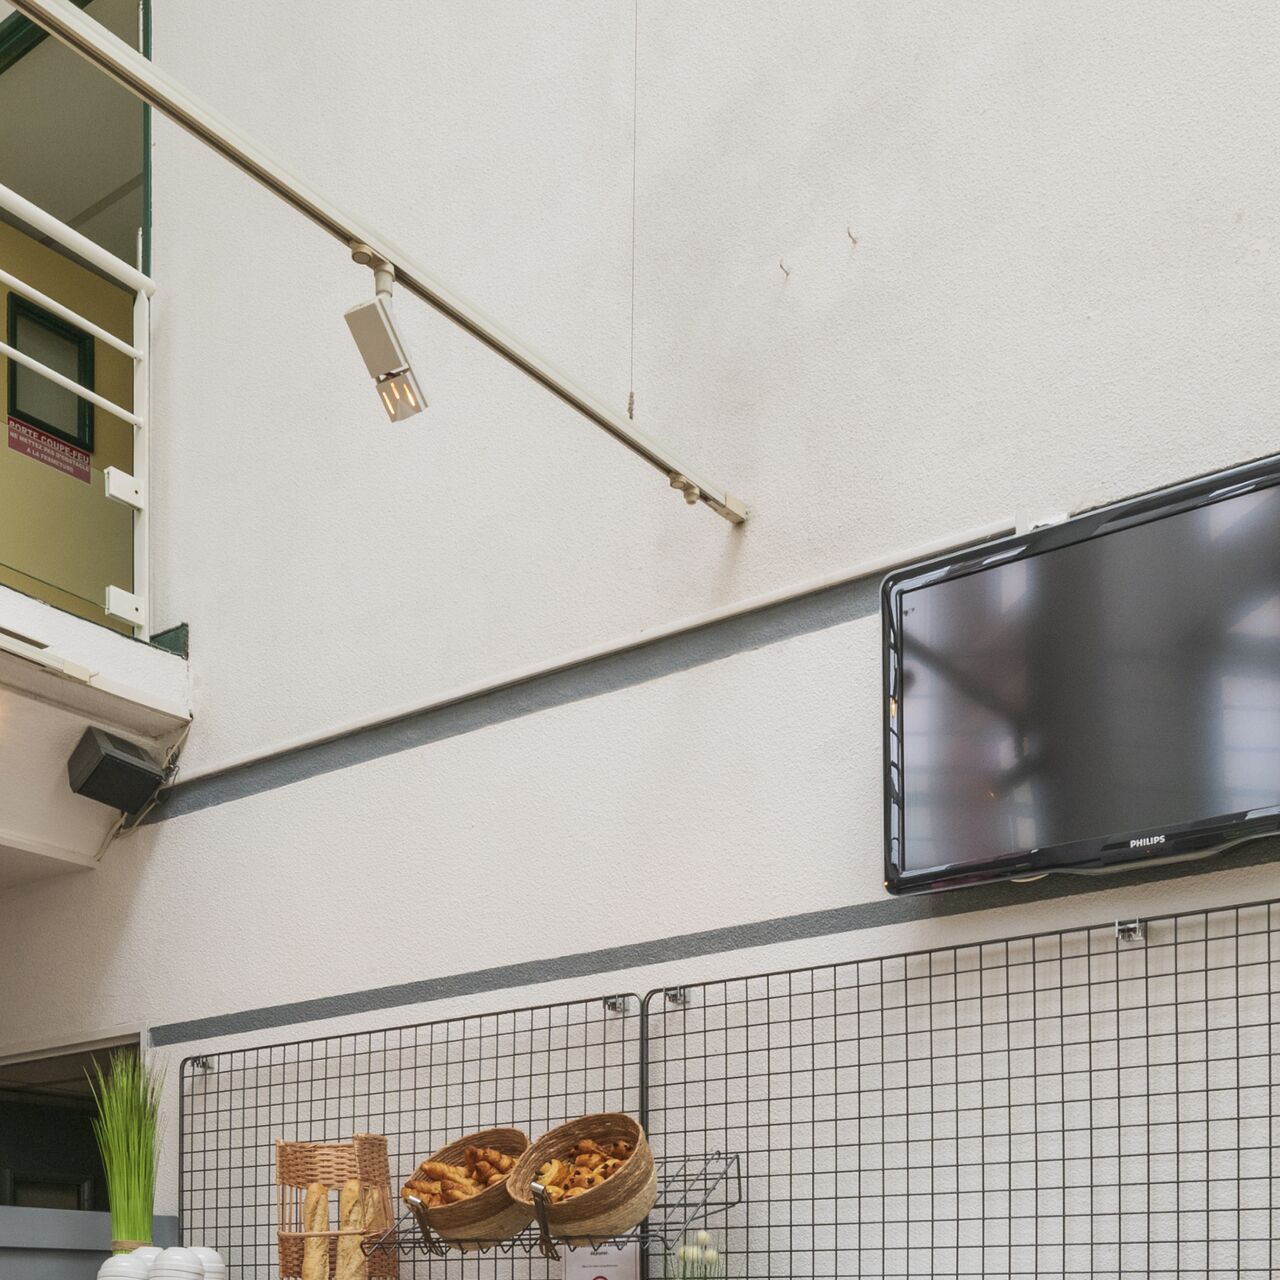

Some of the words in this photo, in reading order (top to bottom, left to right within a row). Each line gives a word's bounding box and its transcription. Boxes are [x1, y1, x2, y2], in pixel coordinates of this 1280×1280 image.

[9, 420, 39, 438] PORTE
[40, 436, 90, 464] COUPE-FEU
[1130, 834, 1166, 848] PHILIPS
